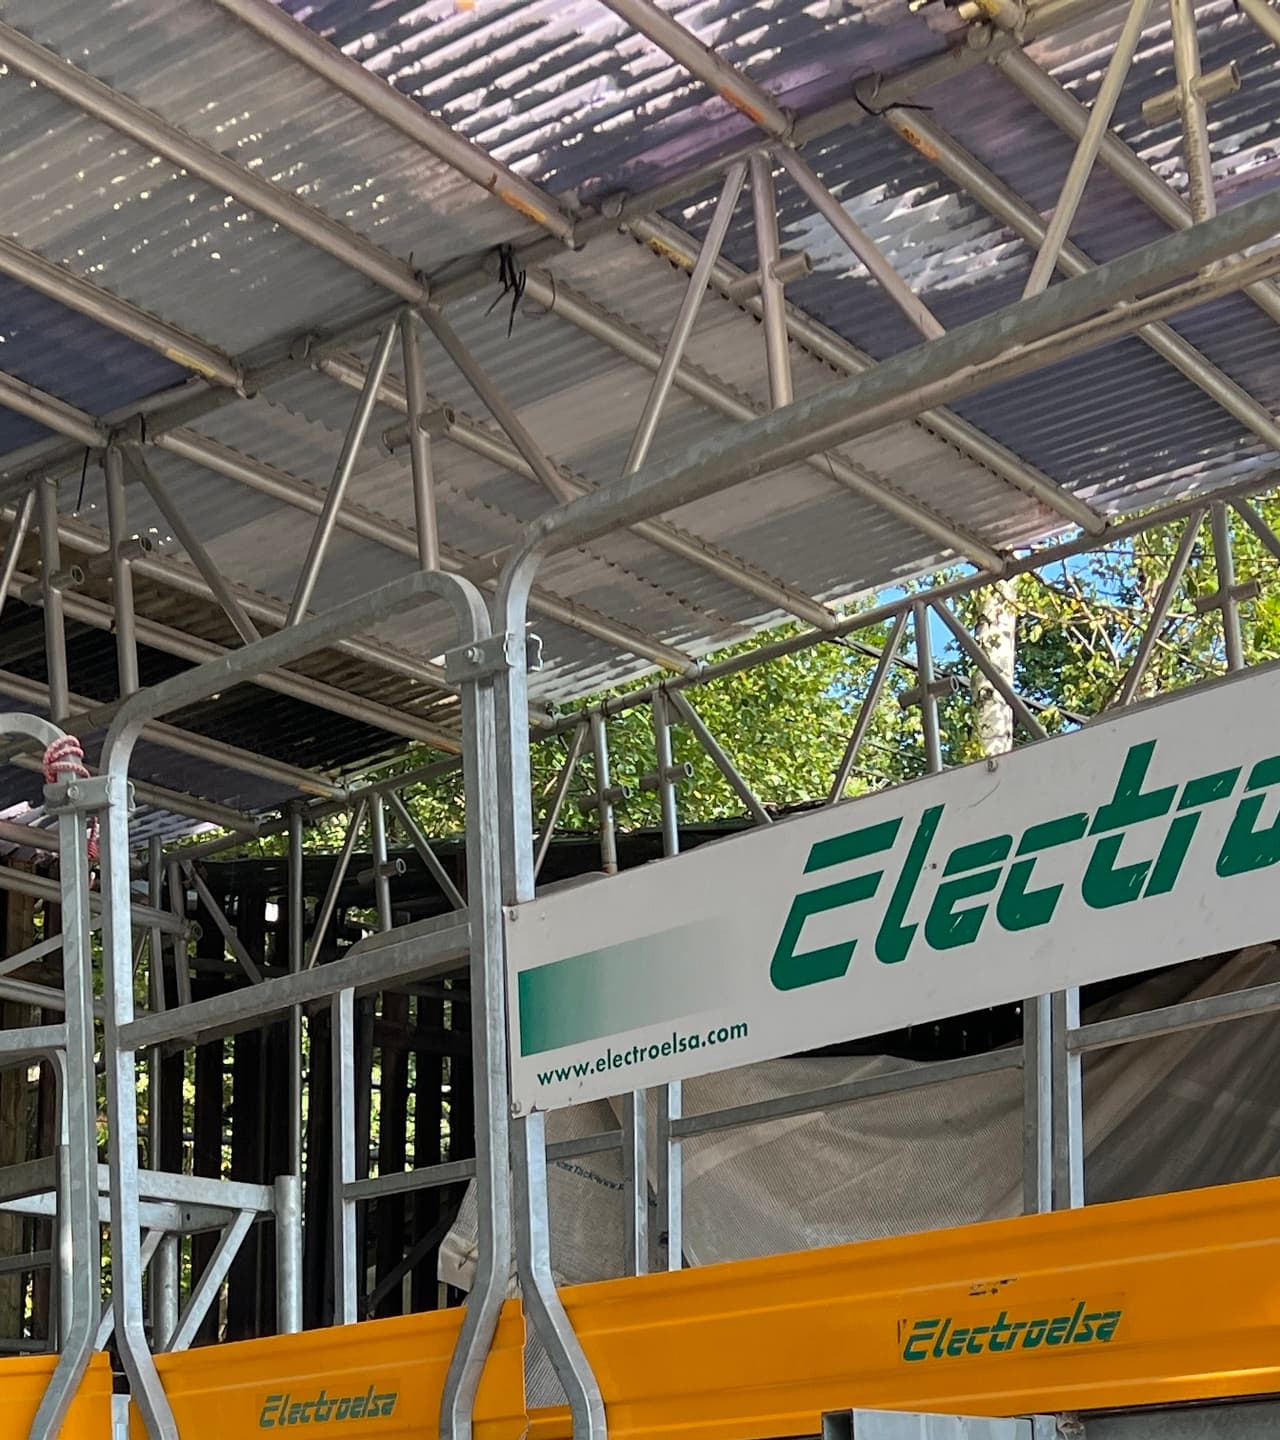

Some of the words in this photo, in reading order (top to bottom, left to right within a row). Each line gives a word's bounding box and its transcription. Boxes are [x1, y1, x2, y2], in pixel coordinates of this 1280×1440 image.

[537, 1021, 748, 1085] www.electroelsa.com
[903, 1301, 1122, 1361] Electroelsa
[260, 1384, 397, 1427] Electroelsa
